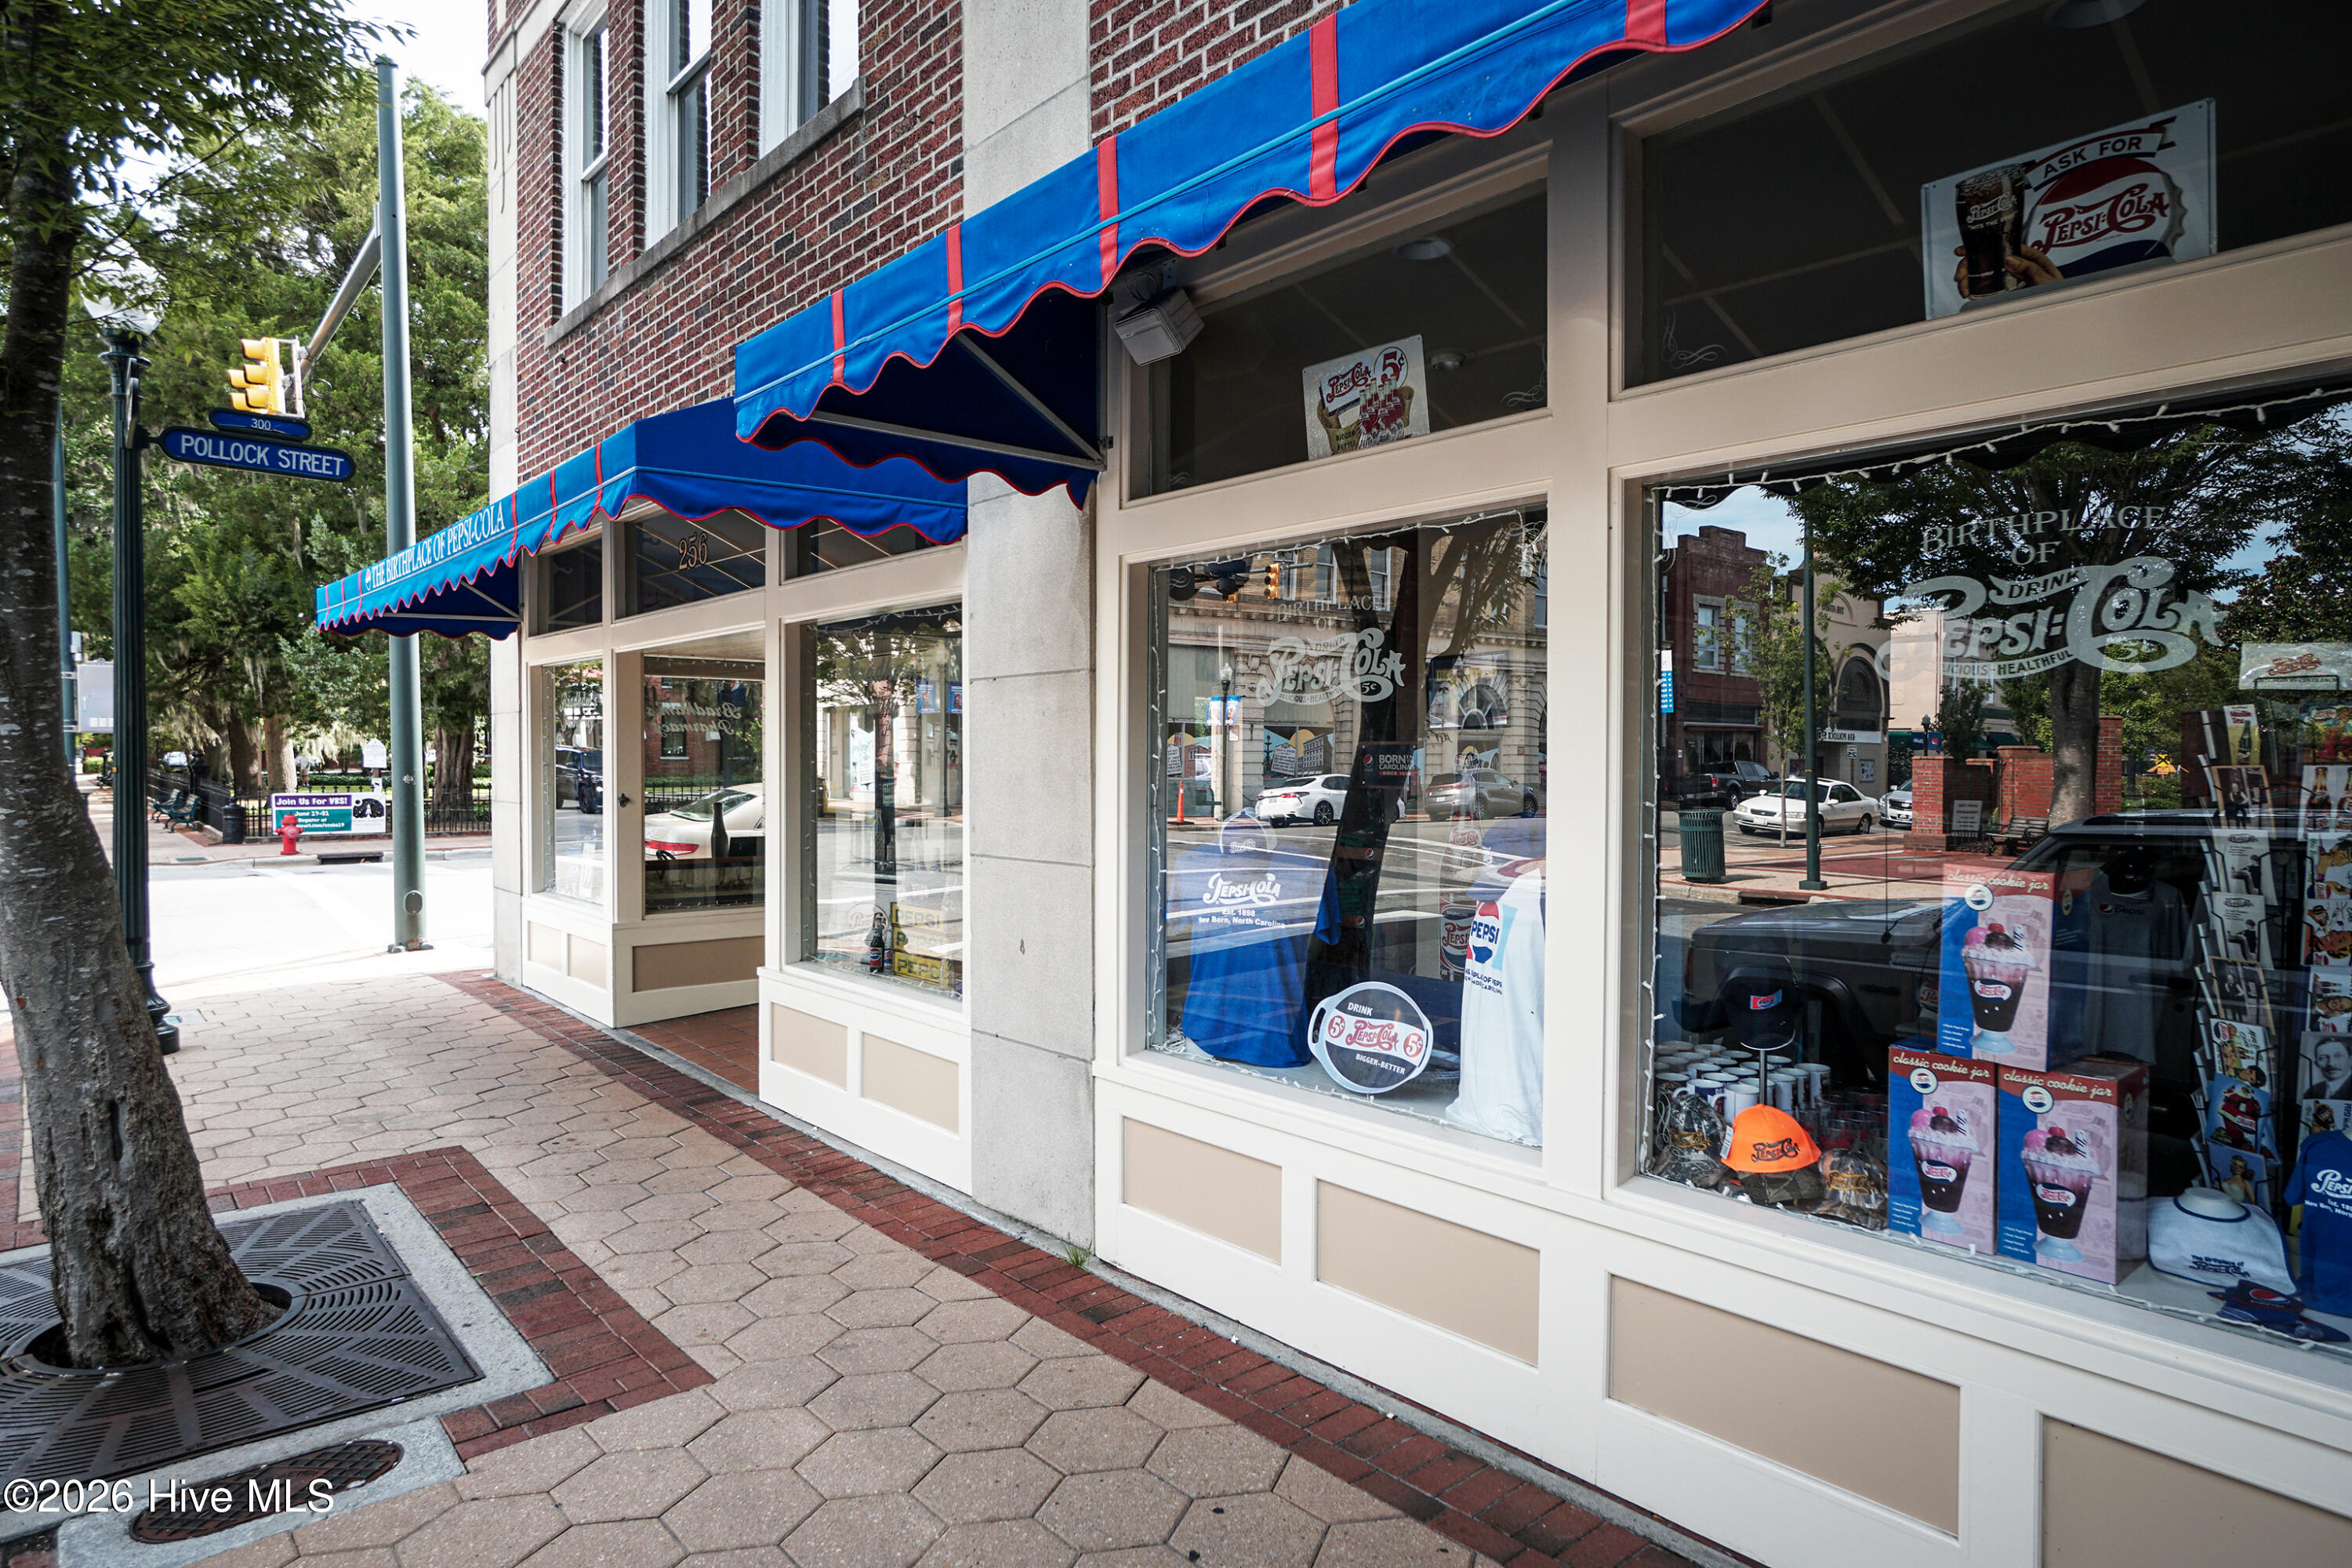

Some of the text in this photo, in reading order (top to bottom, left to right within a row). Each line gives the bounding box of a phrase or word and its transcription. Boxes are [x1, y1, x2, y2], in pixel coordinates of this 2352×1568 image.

[2043, 136, 2143, 179] ASK FOR
[250, 418, 271, 430] 300
[181, 434, 344, 476] POLLOCK STREET
[1921, 506, 2165, 554] BIRTHPLACE
[371, 501, 506, 589] THE BIRTHPLACE OF PEPSI-COLA
[679, 532, 708, 570] 256
[2010, 541, 2061, 565] OF
[2009, 571, 2080, 599] DRINK
[1379, 754, 1406, 764] BORN
[329, 797, 348, 805] VBS!
[1947, 870, 2049, 894] classic cookie jar
[1211, 915, 1231, 924] Bern,
[1471, 920, 1500, 945] PEPSI
[1348, 1002, 1373, 1016] DRINK
[1356, 1053, 1406, 1075] BIGGER-BETTER
[1893, 1052, 1991, 1080] classic cookie jar
[2003, 1070, 2113, 1099] classic cookie jar
